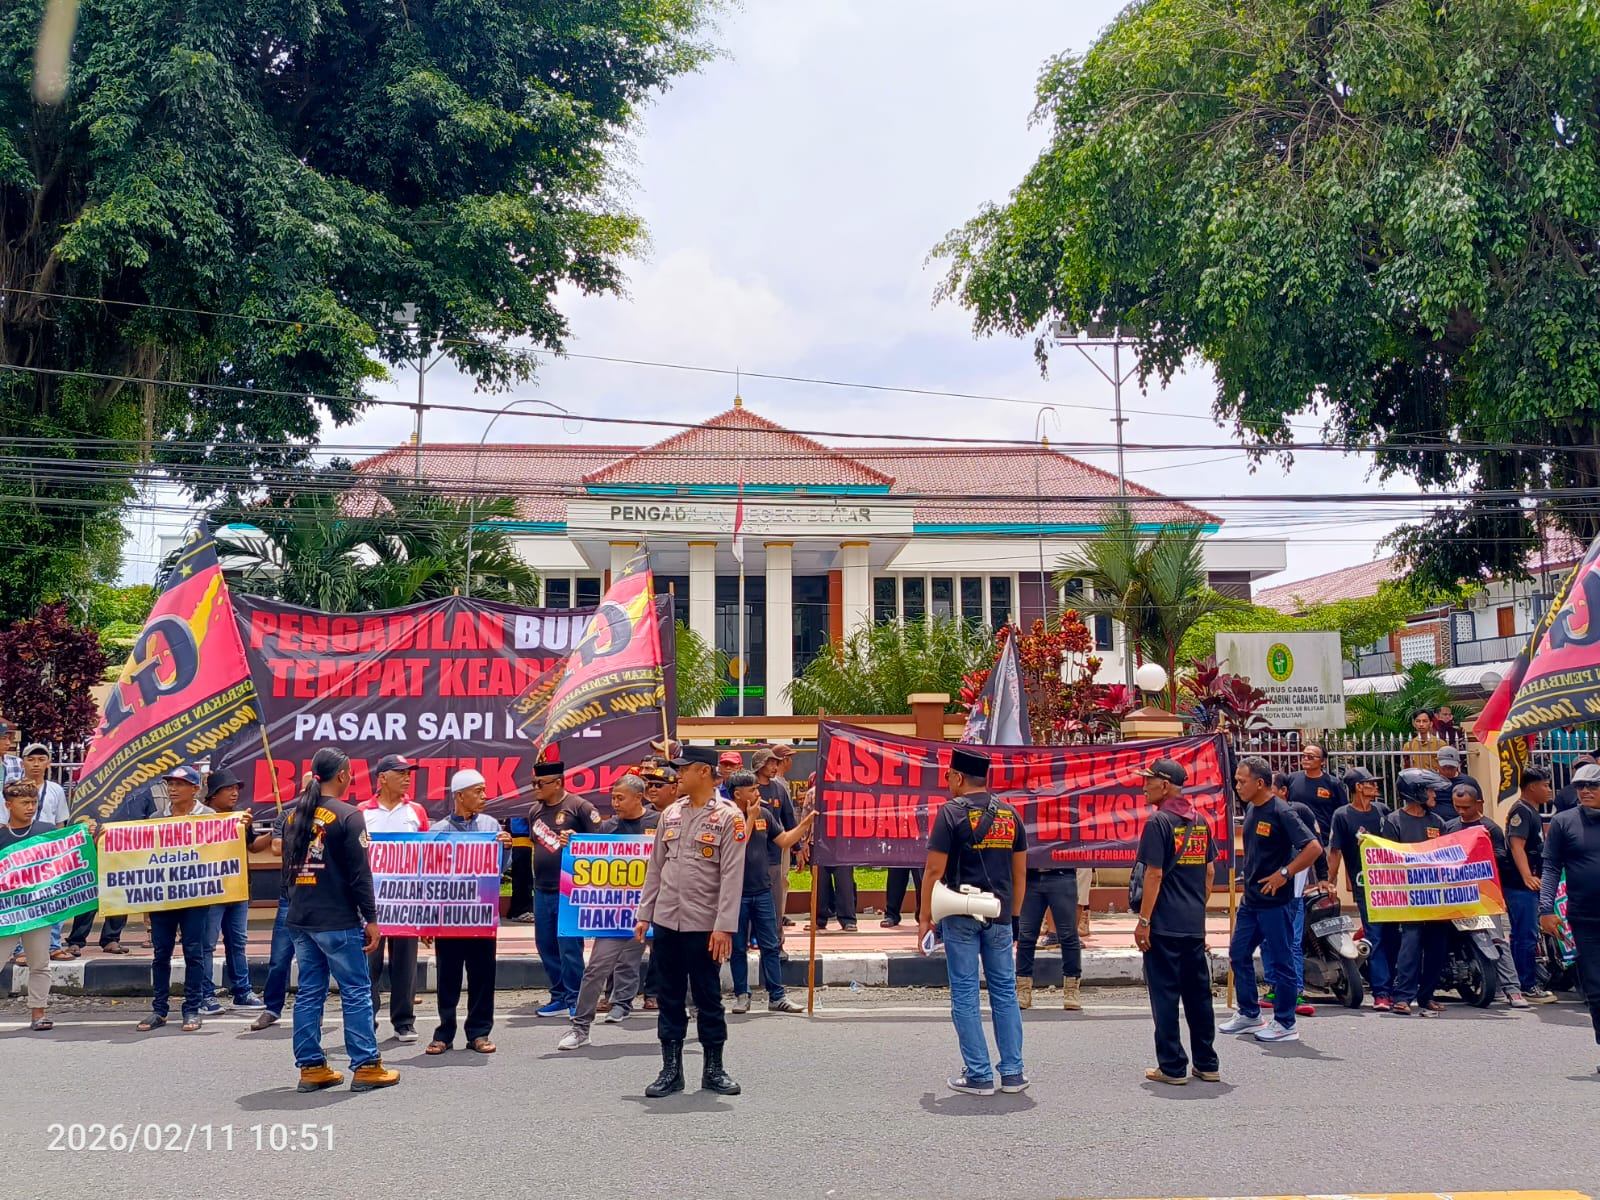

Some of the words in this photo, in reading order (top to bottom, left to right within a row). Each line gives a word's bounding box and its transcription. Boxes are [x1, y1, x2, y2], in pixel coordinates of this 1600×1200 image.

[249, 610, 504, 652] PENGADILAN
[267, 657, 431, 698] TEMPAT
[1292, 694, 1318, 704] CABANG
[1319, 694, 1341, 704] BLITAR
[294, 712, 407, 741] PASAR
[417, 712, 493, 741] SAPI
[824, 735, 930, 787] ASET
[701, 822, 725, 832] POLRI
[822, 790, 920, 839] TIDAK
[1036, 794, 1071, 840] DI
[104, 825, 156, 852] HUKUM
[157, 821, 193, 849] YANG
[194, 817, 240, 846] BURUK
[11, 831, 86, 866] HANYALAH
[149, 850, 199, 865] Adalah
[421, 842, 453, 874] YANG
[454, 842, 499, 874] DIJUAL
[571, 842, 609, 855] HAKIM
[612, 842, 640, 855] YANG
[1051, 850, 1093, 861] GERAKAN
[106, 867, 165, 888] BENTUK
[169, 859, 240, 881] KEADILAN
[573, 858, 648, 887] SOGO
[1368, 869, 1407, 885] SEMAKIN
[1407, 867, 1441, 884] BANYAK
[1441, 862, 1493, 882] PELANGGARAN
[13, 888, 53, 906] ADALAH
[53, 871, 95, 895] SESUATU
[125, 885, 164, 904] YANG
[167, 879, 224, 901] BRUTAL
[378, 880, 423, 900] ADALAH
[426, 880, 477, 900] SEBUAH
[571, 890, 623, 904] ADALAH
[1370, 890, 1408, 906] SEMAKIN
[1409, 889, 1442, 905] SEDIKIT
[1443, 885, 1480, 903] KEADILAN
[27, 898, 68, 919] DENGAN
[442, 904, 493, 925] HUKUM
[579, 909, 616, 928] HAK
